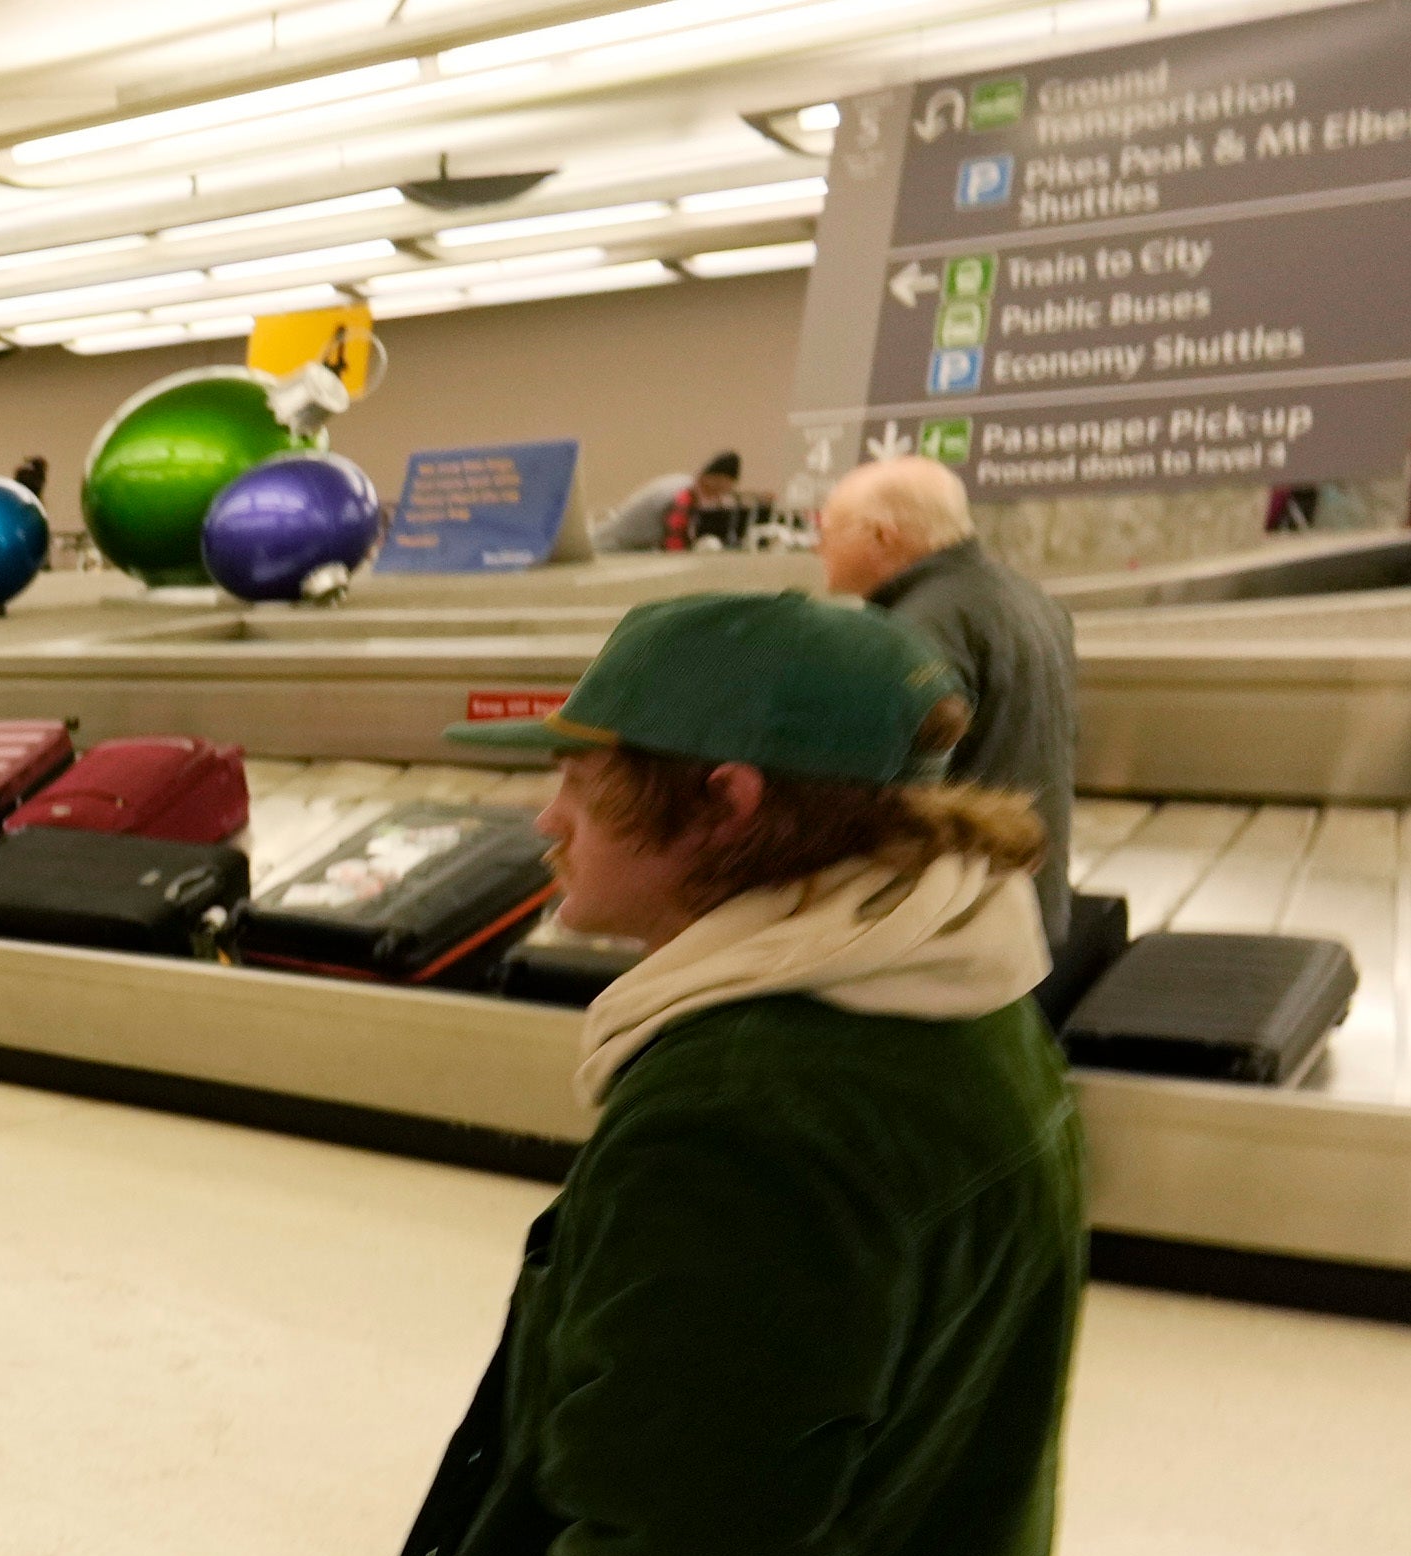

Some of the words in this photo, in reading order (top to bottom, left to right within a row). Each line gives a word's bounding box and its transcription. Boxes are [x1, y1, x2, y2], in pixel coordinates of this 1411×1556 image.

[1033, 78, 1296, 144] Transportation
[1038, 58, 1169, 112] Ground
[1023, 153, 1110, 191] Pikes
[1119, 135, 1203, 179] Peak
[1212, 127, 1246, 167] &
[1255, 118, 1311, 160] Mt
[1321, 104, 1411, 150] Elbe
[1019, 180, 1161, 227] Shuttles
[1009, 251, 1087, 288] Train
[1095, 248, 1133, 279] to
[1140, 236, 1212, 279] City
[1001, 295, 1102, 337] Public
[1108, 287, 1211, 327] Buses
[993, 344, 1146, 385] Economy
[1152, 325, 1305, 370] Shuttles
[982, 415, 1163, 456] Passenger
[1170, 401, 1314, 443] Pick-up
[1161, 448, 1191, 476] to
